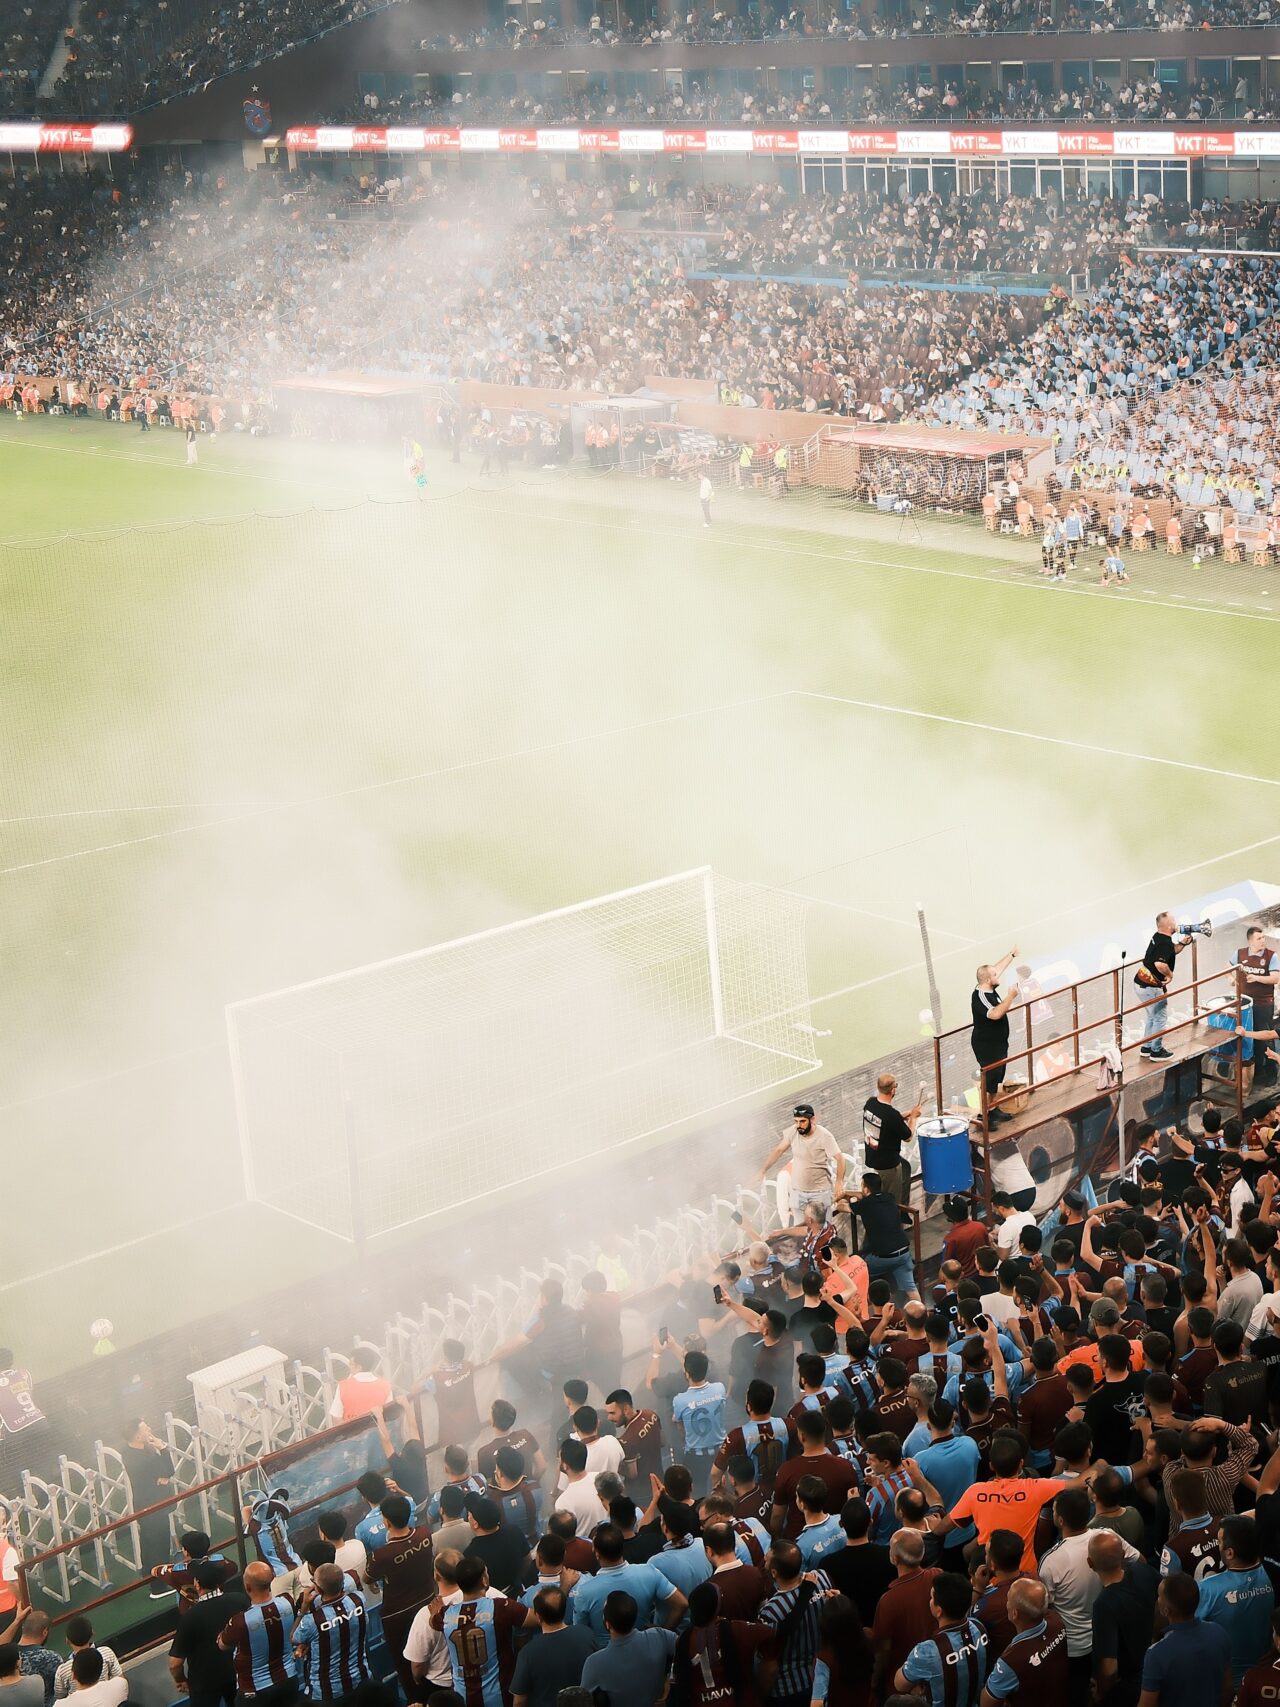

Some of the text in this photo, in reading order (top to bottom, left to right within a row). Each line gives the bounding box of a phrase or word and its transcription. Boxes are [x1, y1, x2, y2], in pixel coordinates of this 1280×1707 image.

[43, 131, 67, 142] YKT
[353, 132, 369, 145] YKT
[425, 133, 441, 145] YKT
[500, 134, 516, 145] YKT
[580, 134, 597, 146] YKT
[664, 134, 683, 147] YKT
[709, 136, 728, 145] YKT
[753, 134, 773, 147] YKT
[800, 136, 821, 146] YKT
[848, 135, 870, 148] YKT
[900, 136, 920, 146] YKT
[950, 136, 973, 149] YKT
[1005, 137, 1027, 147] YKT
[1058, 136, 1084, 150] YKT
[1118, 137, 1140, 150] YKT
[1176, 137, 1201, 150] YKT
[1239, 138, 1264, 150] YKT
[851, 1366, 876, 1386] onv
[638, 1413, 658, 1440] onvo
[976, 1490, 1026, 1505] onvo
[393, 1536, 430, 1565] onvo
[319, 1605, 364, 1632] onvo
[448, 1625, 489, 1666] 10
[945, 1632, 990, 1666] onvo
[701, 1686, 734, 1702] HAVV
